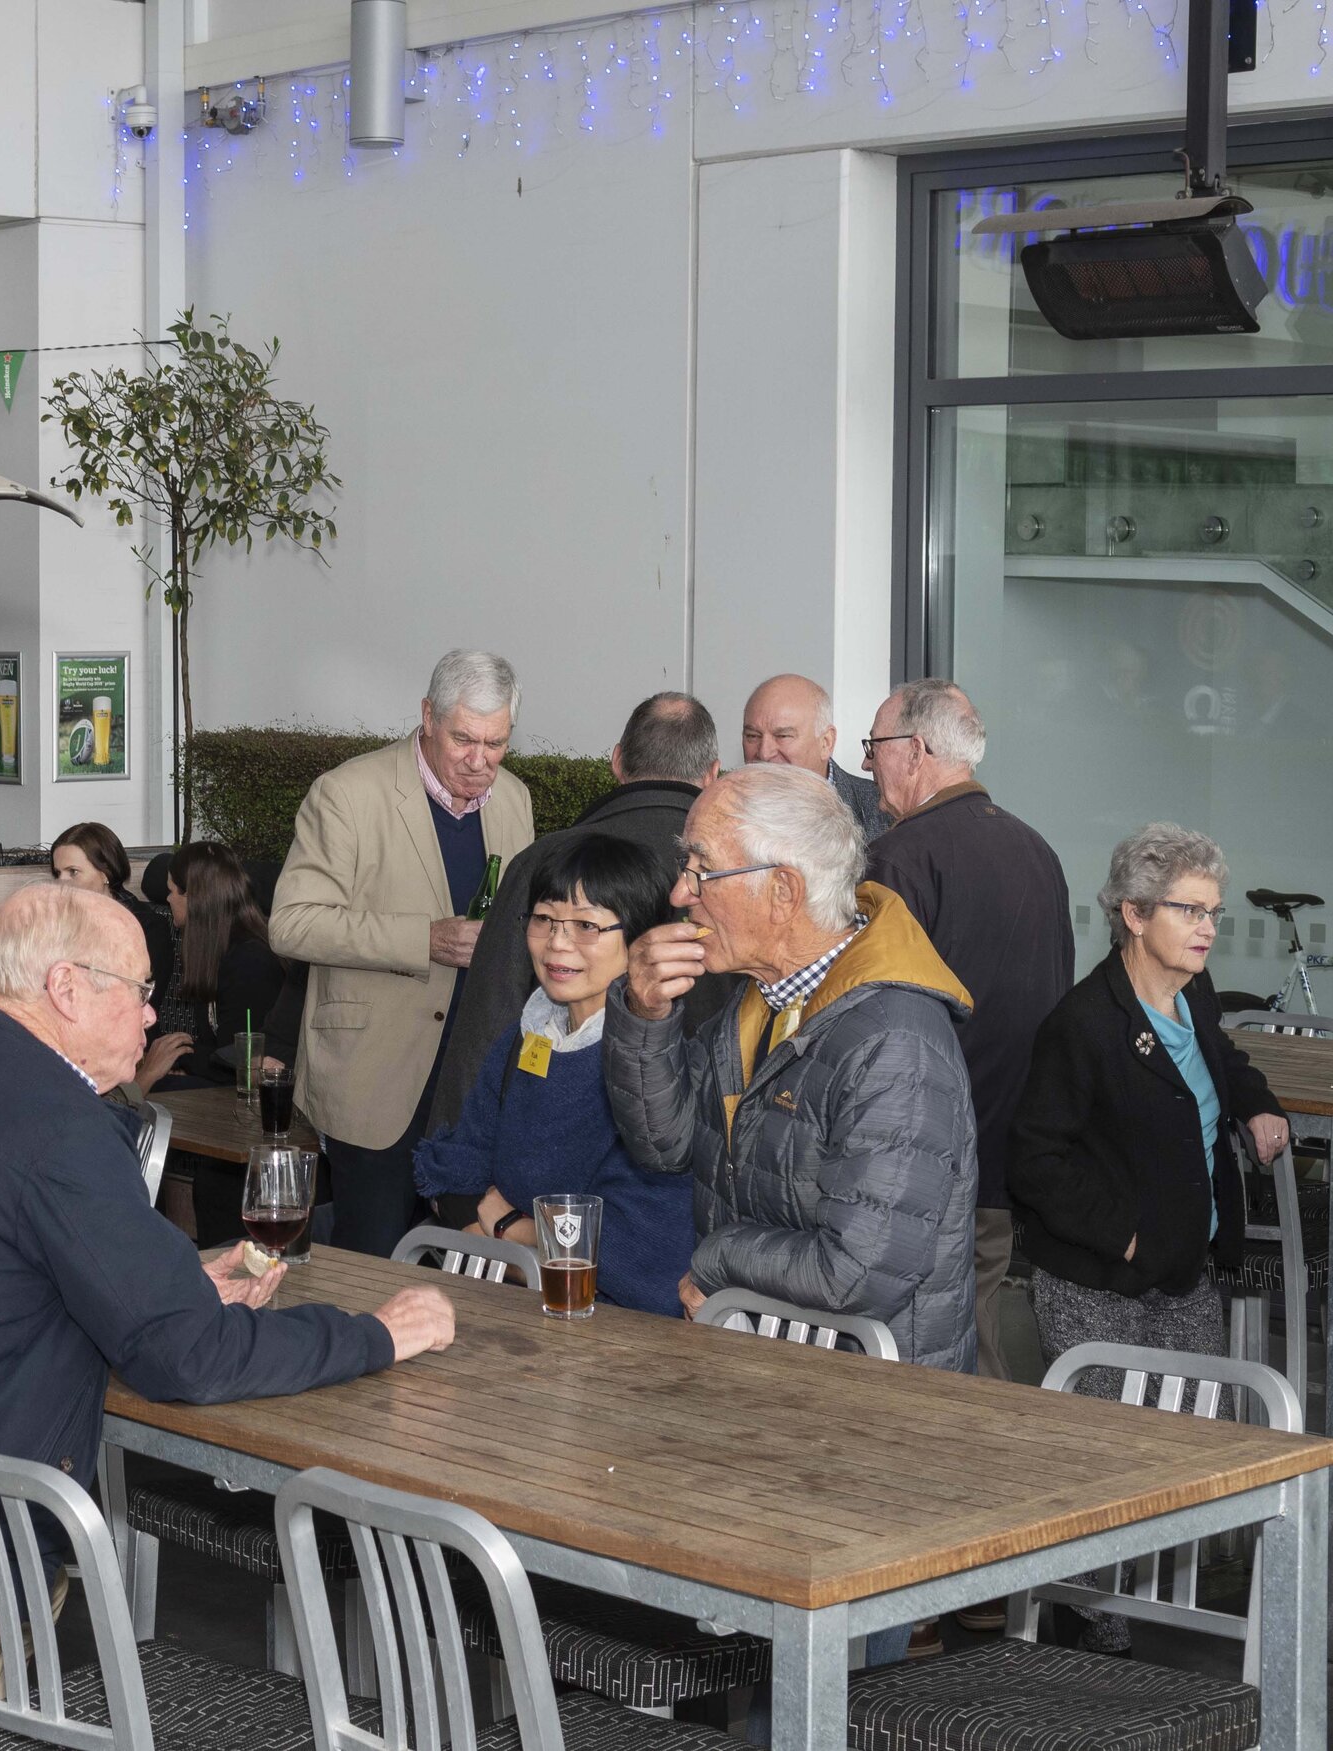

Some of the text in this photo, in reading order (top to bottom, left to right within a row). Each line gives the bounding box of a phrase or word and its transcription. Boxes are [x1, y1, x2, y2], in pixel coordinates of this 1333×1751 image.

[4, 364, 12, 399] Heineken
[62, 665, 118, 677] Try your luck!
